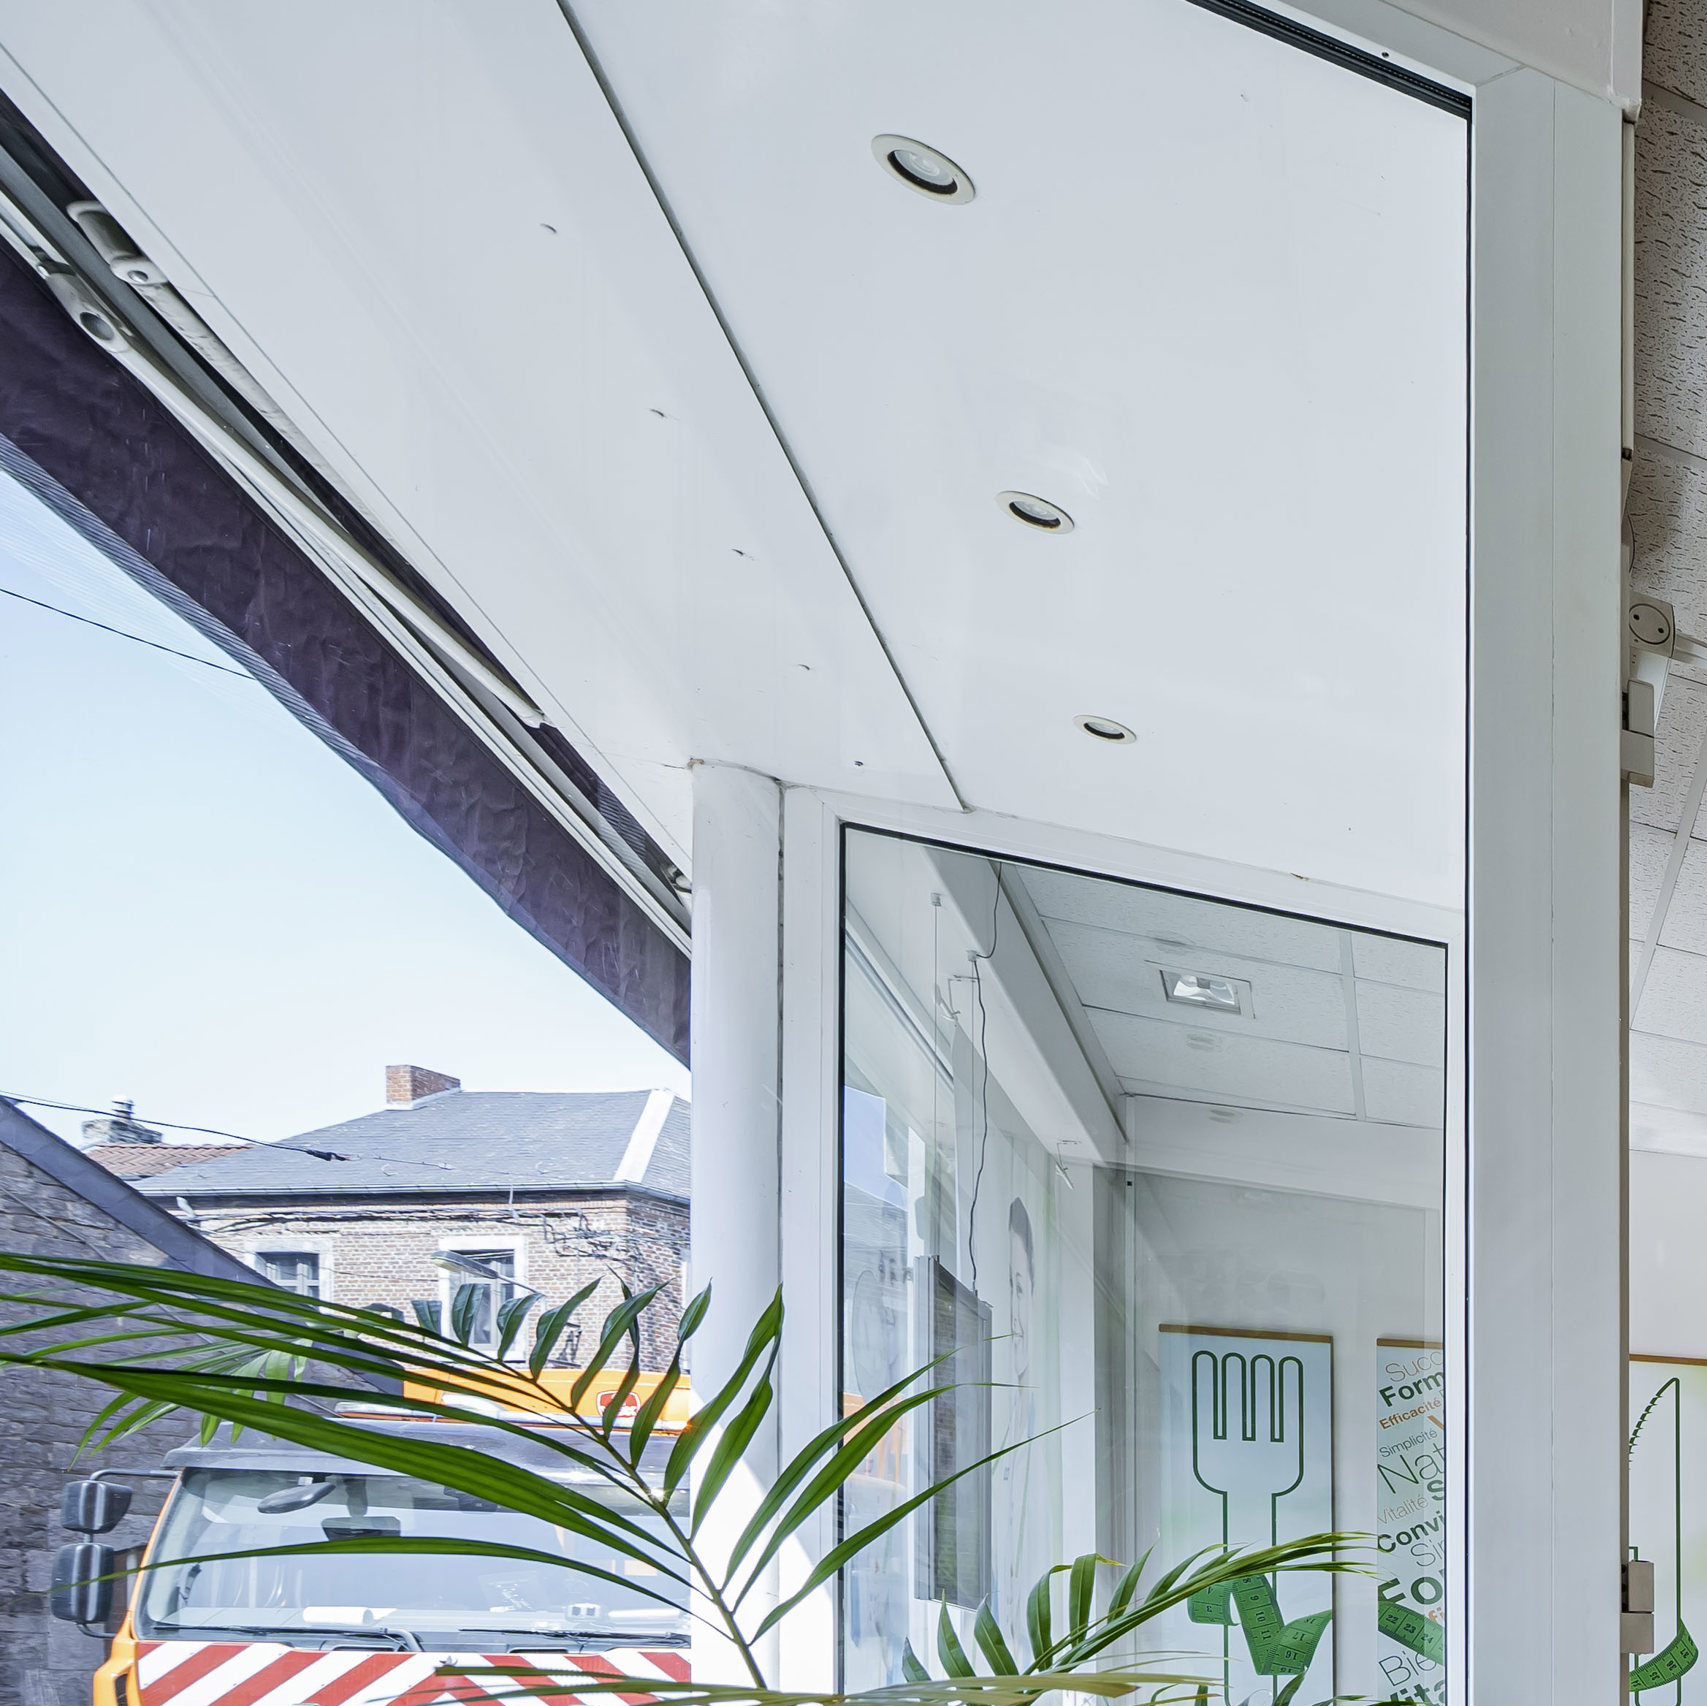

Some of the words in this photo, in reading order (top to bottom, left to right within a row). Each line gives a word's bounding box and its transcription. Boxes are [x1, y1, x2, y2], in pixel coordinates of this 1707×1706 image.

[1379, 1396, 1443, 1430] Efficacité
[1379, 1427, 1439, 1459] Simplicité
[1377, 1493, 1430, 1526] Vitalité
[1256, 1611, 1266, 1622] 10
[1261, 1629, 1272, 1640] 11
[1292, 1633, 1305, 1641] 17
[1285, 1651, 1298, 1660] 16
